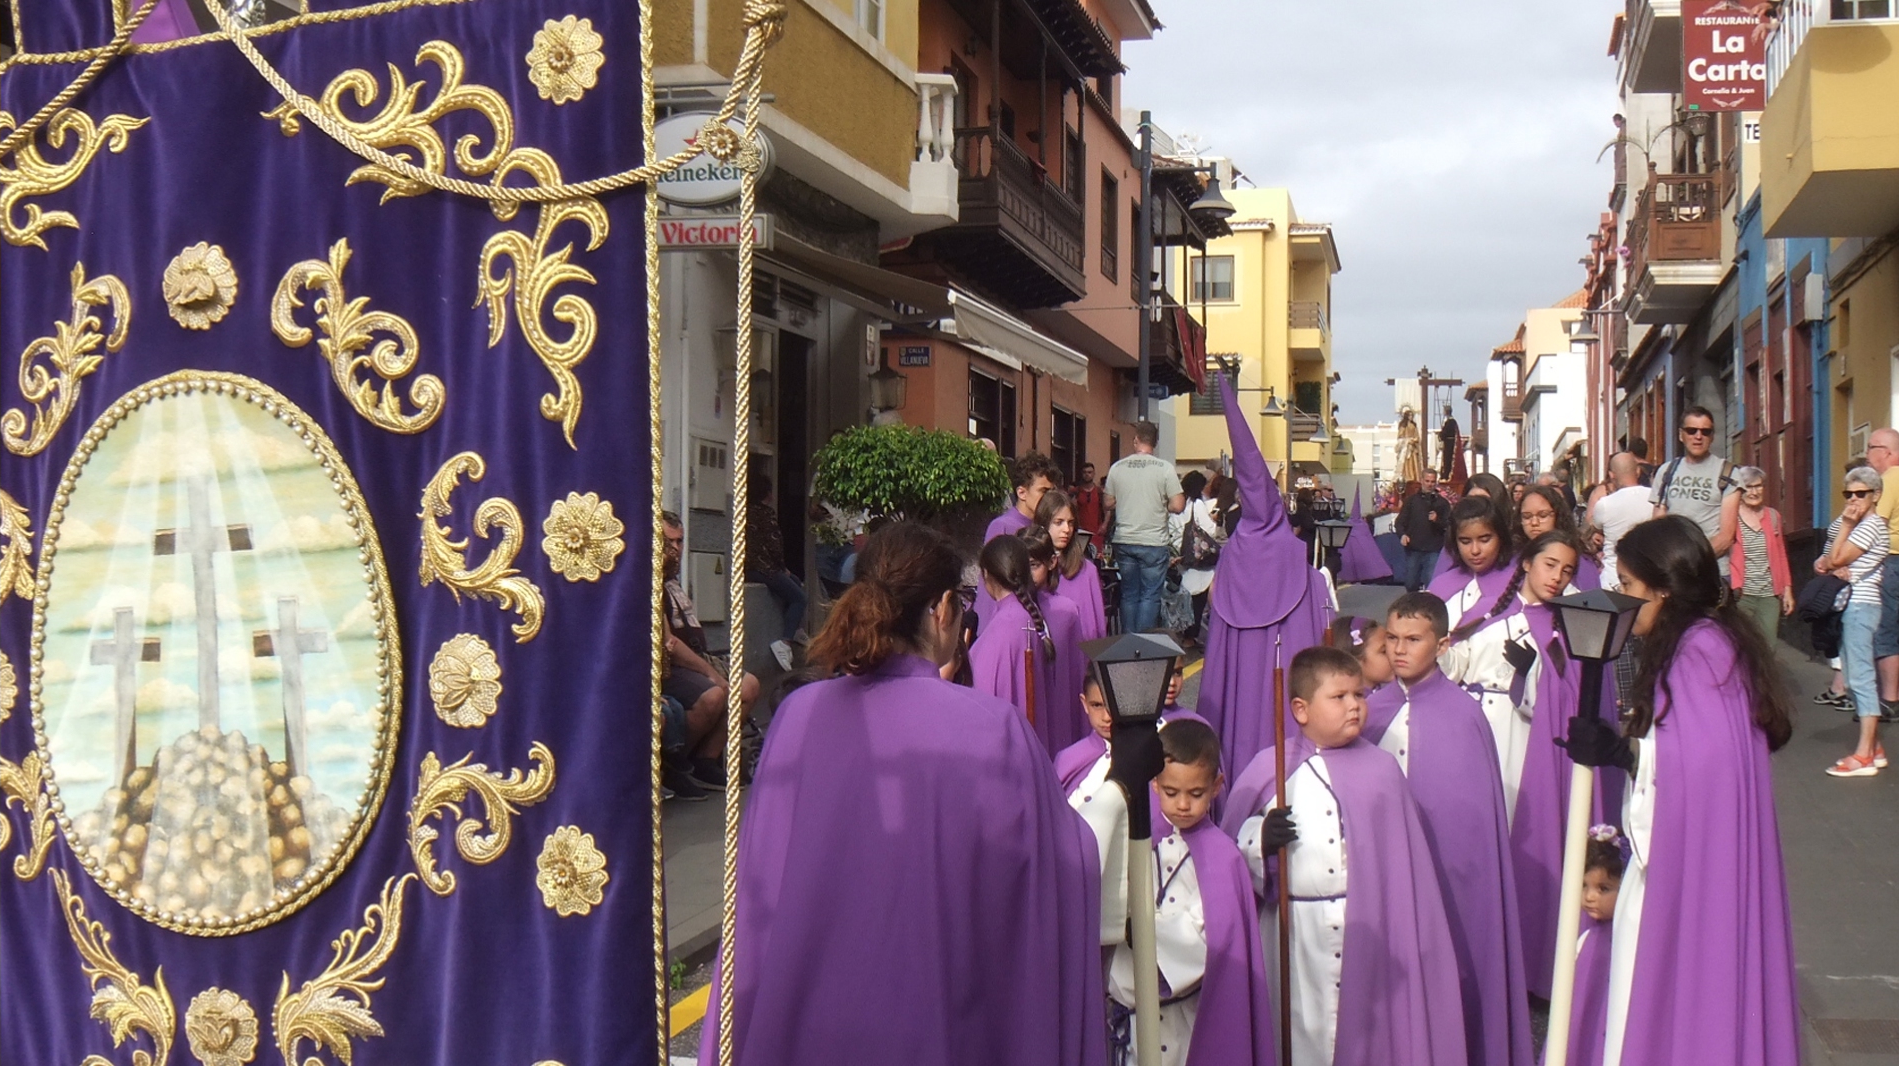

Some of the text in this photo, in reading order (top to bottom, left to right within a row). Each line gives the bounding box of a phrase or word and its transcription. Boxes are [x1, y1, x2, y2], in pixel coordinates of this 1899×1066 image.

[1712, 29, 1745, 54] La
[1688, 57, 1766, 82] Carta
[658, 163, 742, 183] eineken
[660, 221, 757, 245] Victori
[1668, 487, 1711, 502] ONES
